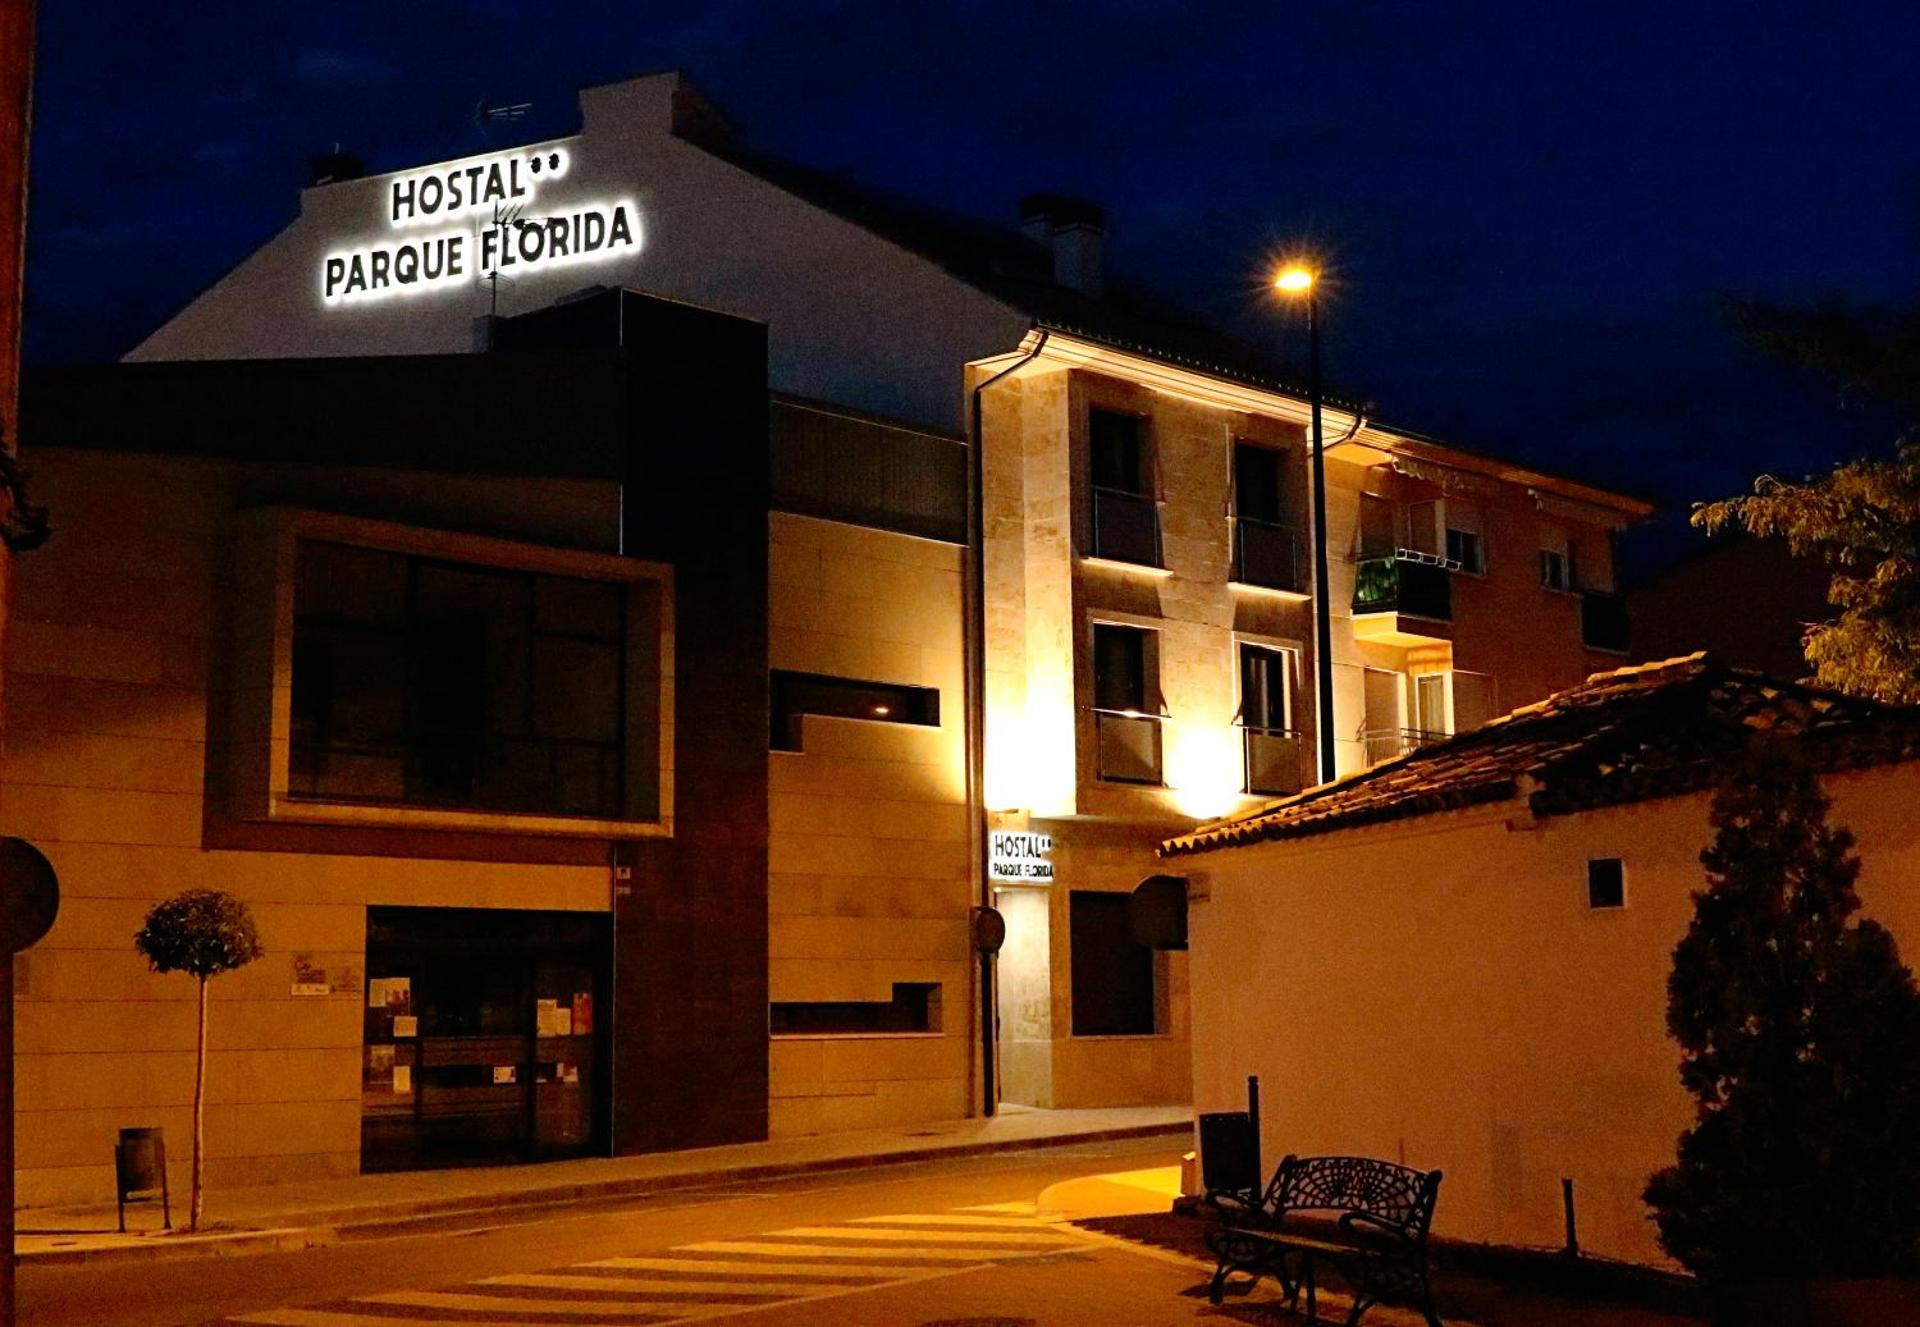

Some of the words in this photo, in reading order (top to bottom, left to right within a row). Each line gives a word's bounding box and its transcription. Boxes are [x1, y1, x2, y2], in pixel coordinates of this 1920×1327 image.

[392, 158, 526, 221] HOSTAL
[326, 236, 463, 297] PARQUE
[482, 206, 633, 270] FLORIDA
[994, 862, 1022, 877] PARQUE
[1025, 864, 1054, 879] FLORIDA
